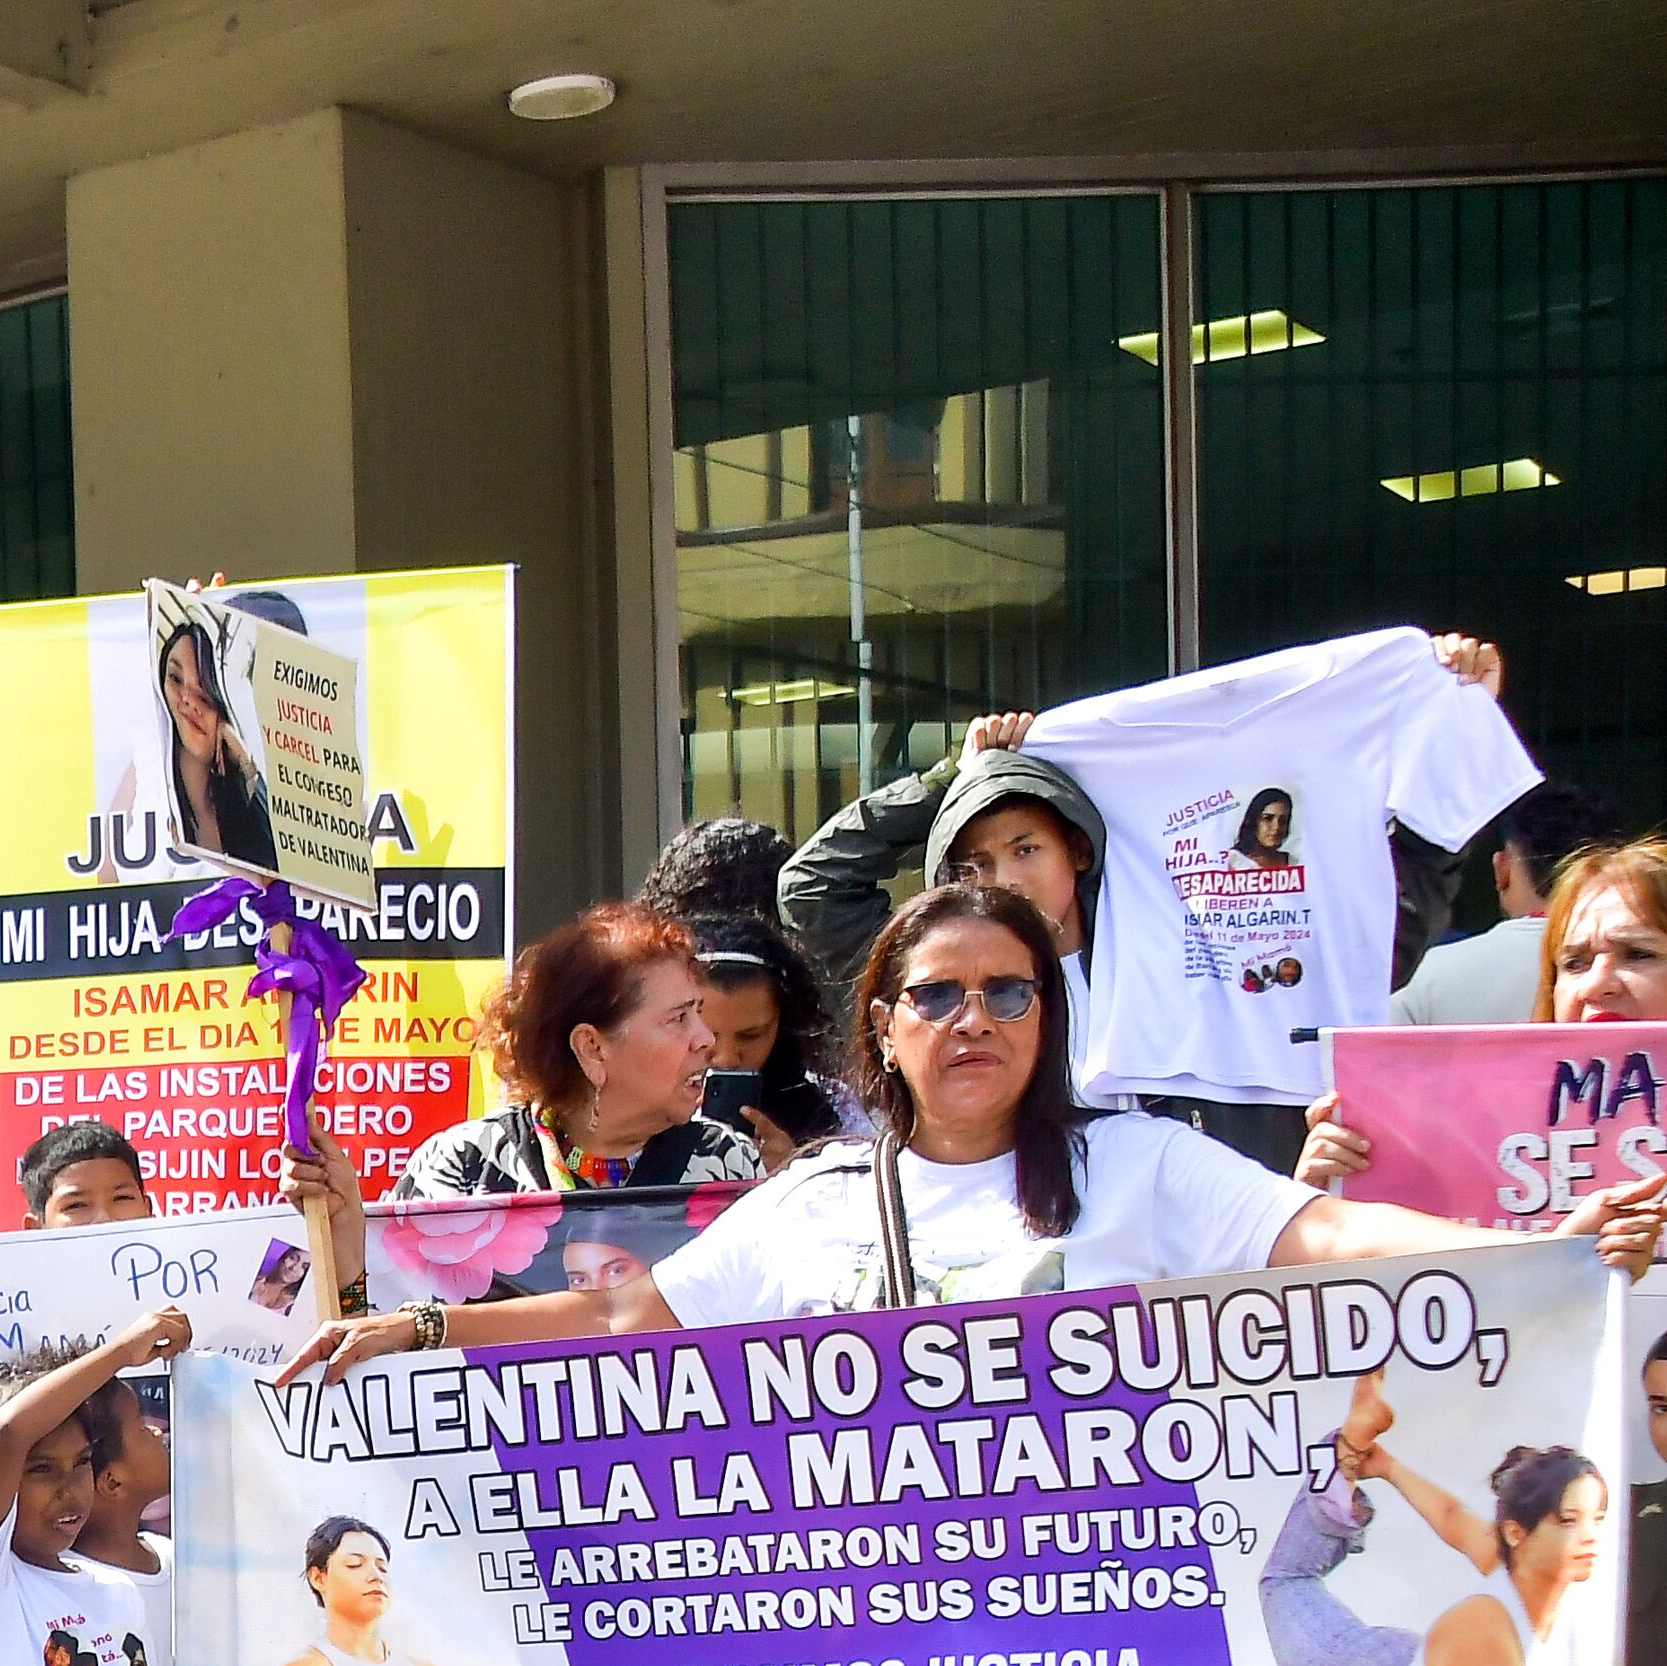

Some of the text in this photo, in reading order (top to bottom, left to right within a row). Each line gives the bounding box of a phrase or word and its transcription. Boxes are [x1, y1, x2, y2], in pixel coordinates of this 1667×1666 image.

[273, 660, 339, 702] EXIGIMOS
[276, 697, 333, 736] JUSTICIA
[262, 724, 361, 776] Y CARCEL PARA
[277, 763, 293, 786] EL
[270, 794, 368, 842] MALTRATADOR
[1166, 789, 1235, 827] JUSTICIA
[278, 830, 370, 877] DE VALENTINA
[1174, 837, 1199, 854] MI
[1262, 897, 1274, 908] A
[1, 908, 45, 964] MI
[68, 899, 163, 959] HIJA
[73, 979, 228, 1018] ISAMAR
[9, 1029, 129, 1061] DESDE
[154, 1025, 188, 1053] EL
[200, 1022, 258, 1050] DIA
[324, 1018, 358, 1046] DE
[373, 1015, 477, 1044] MAYO
[15, 1062, 452, 1107] DE LAS INSTALCIONES
[139, 1146, 282, 1180] SIJIN LO
[112, 1241, 220, 1302] POR
[255, 1269, 1510, 1462] VALENTINA NO SE SUICIDO,
[404, 1390, 1340, 1540] A ELLA LA MATARON,
[477, 1500, 1258, 1593] LE ARREBATARON SU FUTURO,
[512, 1561, 1227, 1646] LE CORTARON SUS SUEÑOS.
